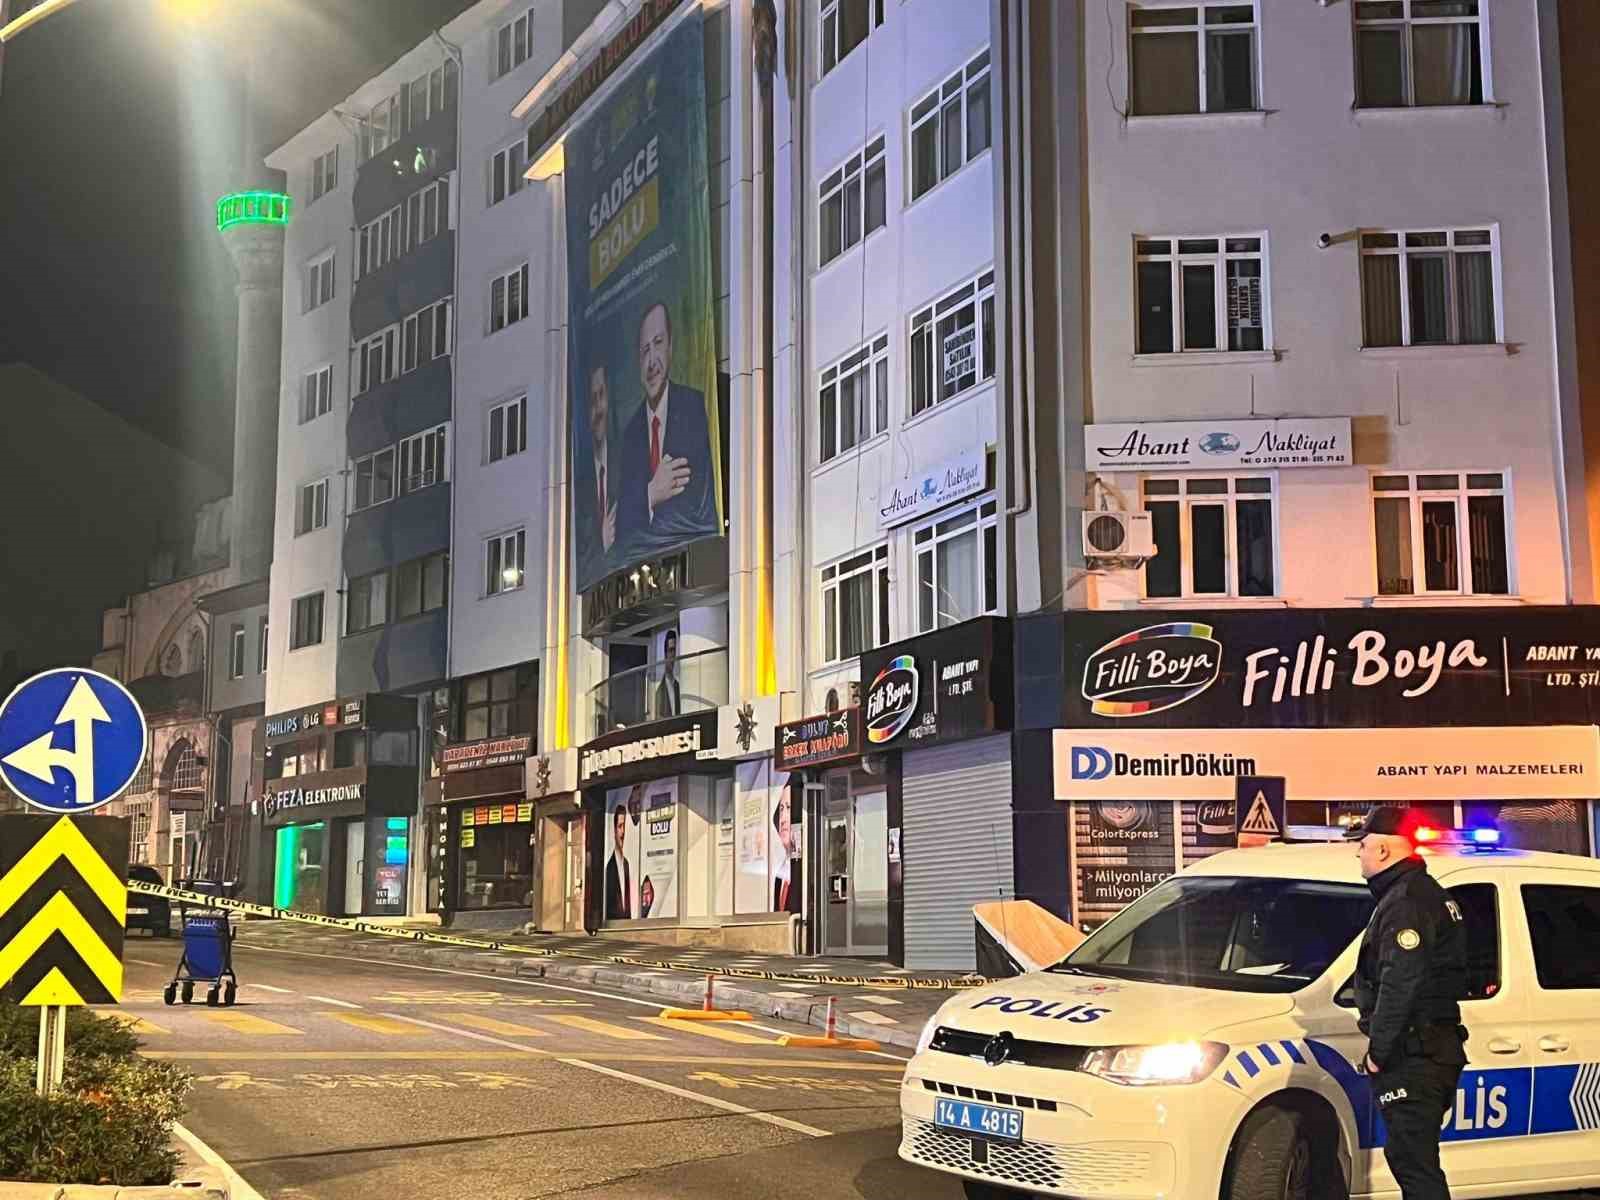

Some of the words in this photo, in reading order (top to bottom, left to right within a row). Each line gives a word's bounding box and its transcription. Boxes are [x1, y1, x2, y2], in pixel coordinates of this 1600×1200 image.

[590, 136, 658, 239] SADECE
[600, 197, 645, 272] BOLU
[1097, 429, 1189, 457] Abant
[1245, 430, 1336, 455] Nakliyat
[881, 488, 918, 517] Abant
[938, 464, 978, 495] Nakliyat
[1526, 646, 1579, 661] ABANT
[1096, 653, 1141, 689] Filli
[1147, 650, 1213, 683] Boya
[1243, 635, 1337, 706] Filli
[1348, 630, 1487, 697] Boya
[1546, 672, 1574, 686] LTD.
[867, 686, 885, 719] Filli
[886, 682, 911, 709] Boya
[266, 715, 297, 737] PHILIPS
[310, 713, 319, 726] LG
[1114, 753, 1256, 776] DemirDöküm
[1377, 765, 1428, 776] ABANT
[1434, 765, 1467, 776] YAPI
[1475, 763, 1583, 775] MALZEMELERİ
[277, 787, 304, 810] FEZA
[305, 783, 361, 805] ELEKTRONİK
[1203, 804, 1226, 820] Filli
[1091, 829, 1159, 841] ColorExpress
[1095, 884, 1150, 900] milyonl
[970, 996, 1112, 1023] POLİS
[940, 1102, 955, 1124] 14
[961, 1106, 971, 1127] A
[981, 1109, 1019, 1135] 4815
